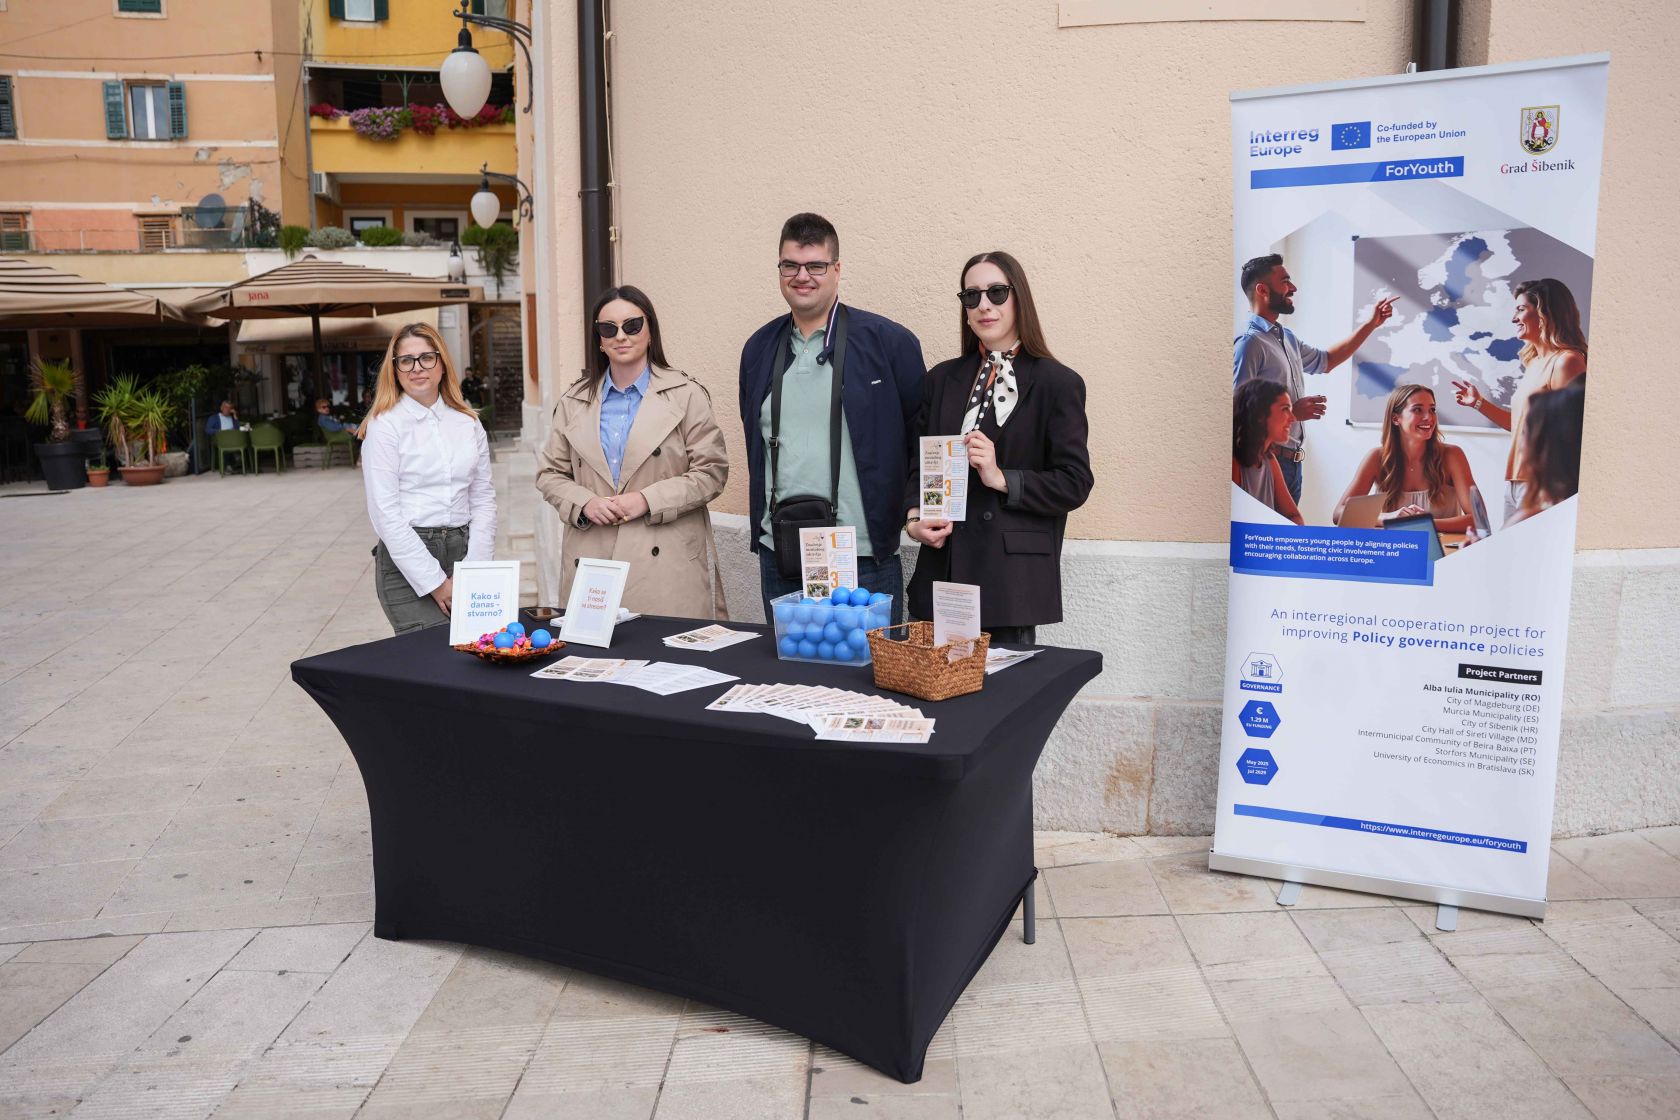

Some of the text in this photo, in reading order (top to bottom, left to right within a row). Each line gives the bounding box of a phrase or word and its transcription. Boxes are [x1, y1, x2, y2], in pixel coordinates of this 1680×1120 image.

[1377, 120, 1437, 132] Co-funded by
[1250, 127, 1319, 144] Interreg
[1377, 128, 1466, 144] the European Union
[1250, 143, 1303, 157] Europe
[1385, 161, 1454, 177] ForYouth
[1500, 157, 1575, 174] Grad Šibenik
[944, 480, 952, 496] 3
[1245, 534, 1418, 550] ForYouth empowers young people by aligning policies
[1276, 544, 1296, 552] needs,
[1298, 545, 1327, 554] fostering
[1328, 546, 1342, 554] civic
[1344, 548, 1384, 556] involvement
[1245, 551, 1282, 560] encouraging
[1284, 552, 1326, 561] collaboration
[1350, 556, 1375, 564] Europe.
[831, 572, 838, 588] 3
[471, 592, 500, 600] Kako si
[1271, 608, 1546, 639] An interregional cooperation project for
[1282, 626, 1544, 657] improving Policy governance policies
[1466, 667, 1537, 682] Project Partners
[1242, 682, 1281, 691] GOVERNANCE
[1424, 684, 1541, 702] Alba Iulia Municipality (RO)
[1447, 697, 1461, 705] City
[1474, 700, 1520, 712] Magdeburg
[1523, 704, 1540, 713] (DE)
[1443, 707, 1539, 723] Murcia Municipality (ES)
[1422, 726, 1436, 735] City
[1439, 727, 1453, 735] Hall
[1456, 728, 1464, 736] of
[1489, 732, 1515, 743] Village
[1517, 736, 1537, 744] (MD)
[1462, 720, 1476, 728] City
[1479, 720, 1487, 728] of
[1520, 726, 1538, 734] (HR)
[1358, 729, 1413, 741] Intermunicipal
[1416, 736, 1461, 747] Community
[1474, 742, 1494, 751] Beira
[1496, 744, 1518, 753] Baixa
[1520, 746, 1536, 755] (PT)
[1374, 752, 1411, 762] University
[1424, 757, 1465, 768] Economics
[1468, 760, 1475, 768] in
[1478, 762, 1516, 774] Bratislava
[1518, 768, 1534, 776] (SK)
[1436, 748, 1535, 766] Storfors Municipality (SE)
[1360, 822, 1521, 850] https://www.interregeurope.eu/foryouth
